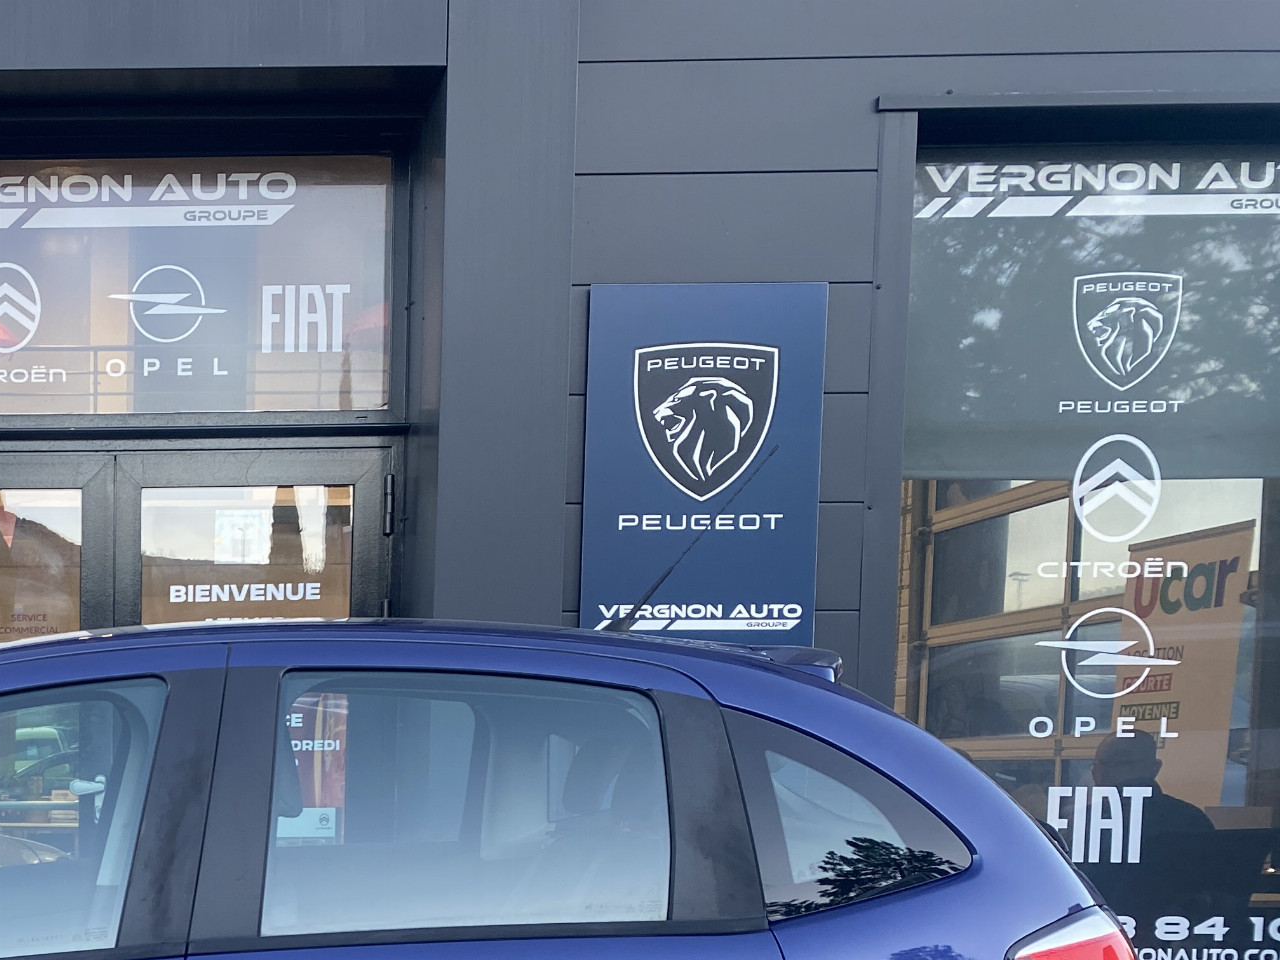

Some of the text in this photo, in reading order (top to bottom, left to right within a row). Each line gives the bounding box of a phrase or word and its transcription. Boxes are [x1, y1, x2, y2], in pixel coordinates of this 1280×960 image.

[924, 161, 1280, 193] VERGNON AU
[148, 172, 297, 201] AUTO
[183, 209, 269, 222] GROUPE
[1082, 281, 1174, 295] PEUGEOT
[261, 283, 351, 354] FIAT
[105, 357, 229, 377] OPEL
[646, 355, 766, 372] PEUGEOT
[1058, 400, 1185, 414] PEUGEOT
[618, 513, 784, 531] PEUGEOT
[169, 582, 321, 603] BIENVENUE
[10, 613, 48, 623] SERVICE
[598, 603, 803, 619] VERGNON AUTO
[1121, 702, 1178, 720] MOYENNE
[1028, 716, 1180, 739] OPEL
[291, 739, 340, 751] DREDI
[1046, 786, 1153, 864] FIAT
[1154, 915, 1231, 942] 84
